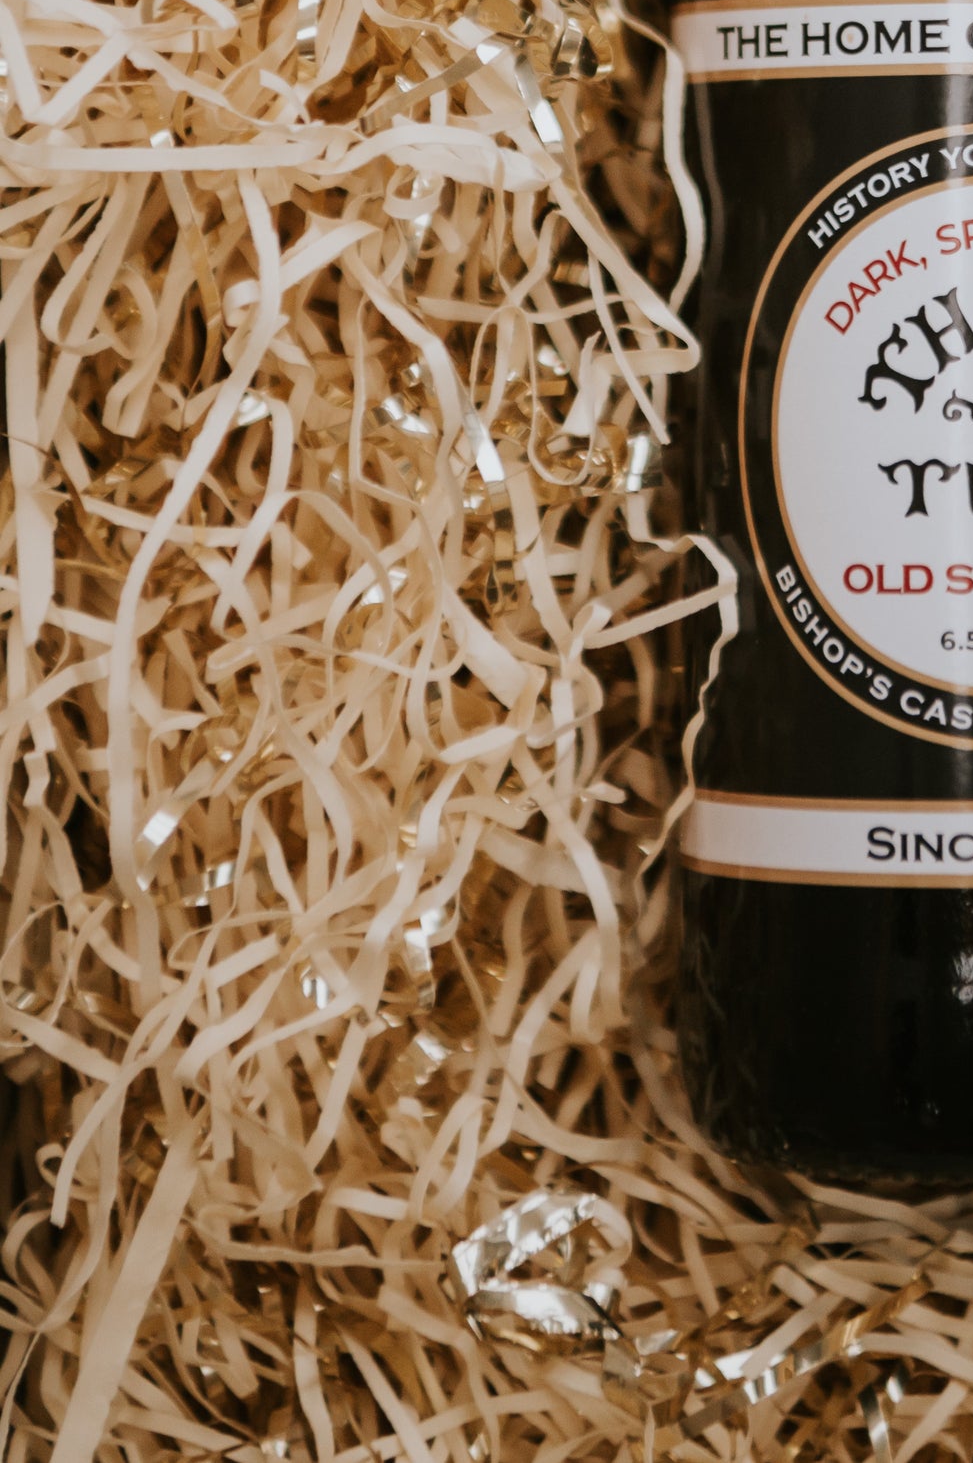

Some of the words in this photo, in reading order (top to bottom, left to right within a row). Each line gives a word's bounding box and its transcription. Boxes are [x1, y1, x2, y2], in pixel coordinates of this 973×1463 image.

[717, 24, 789, 59] THE
[800, 20, 950, 56] HOME
[806, 153, 931, 249] HISTORY
[823, 239, 928, 335] DARK,
[842, 563, 934, 596] OLD
